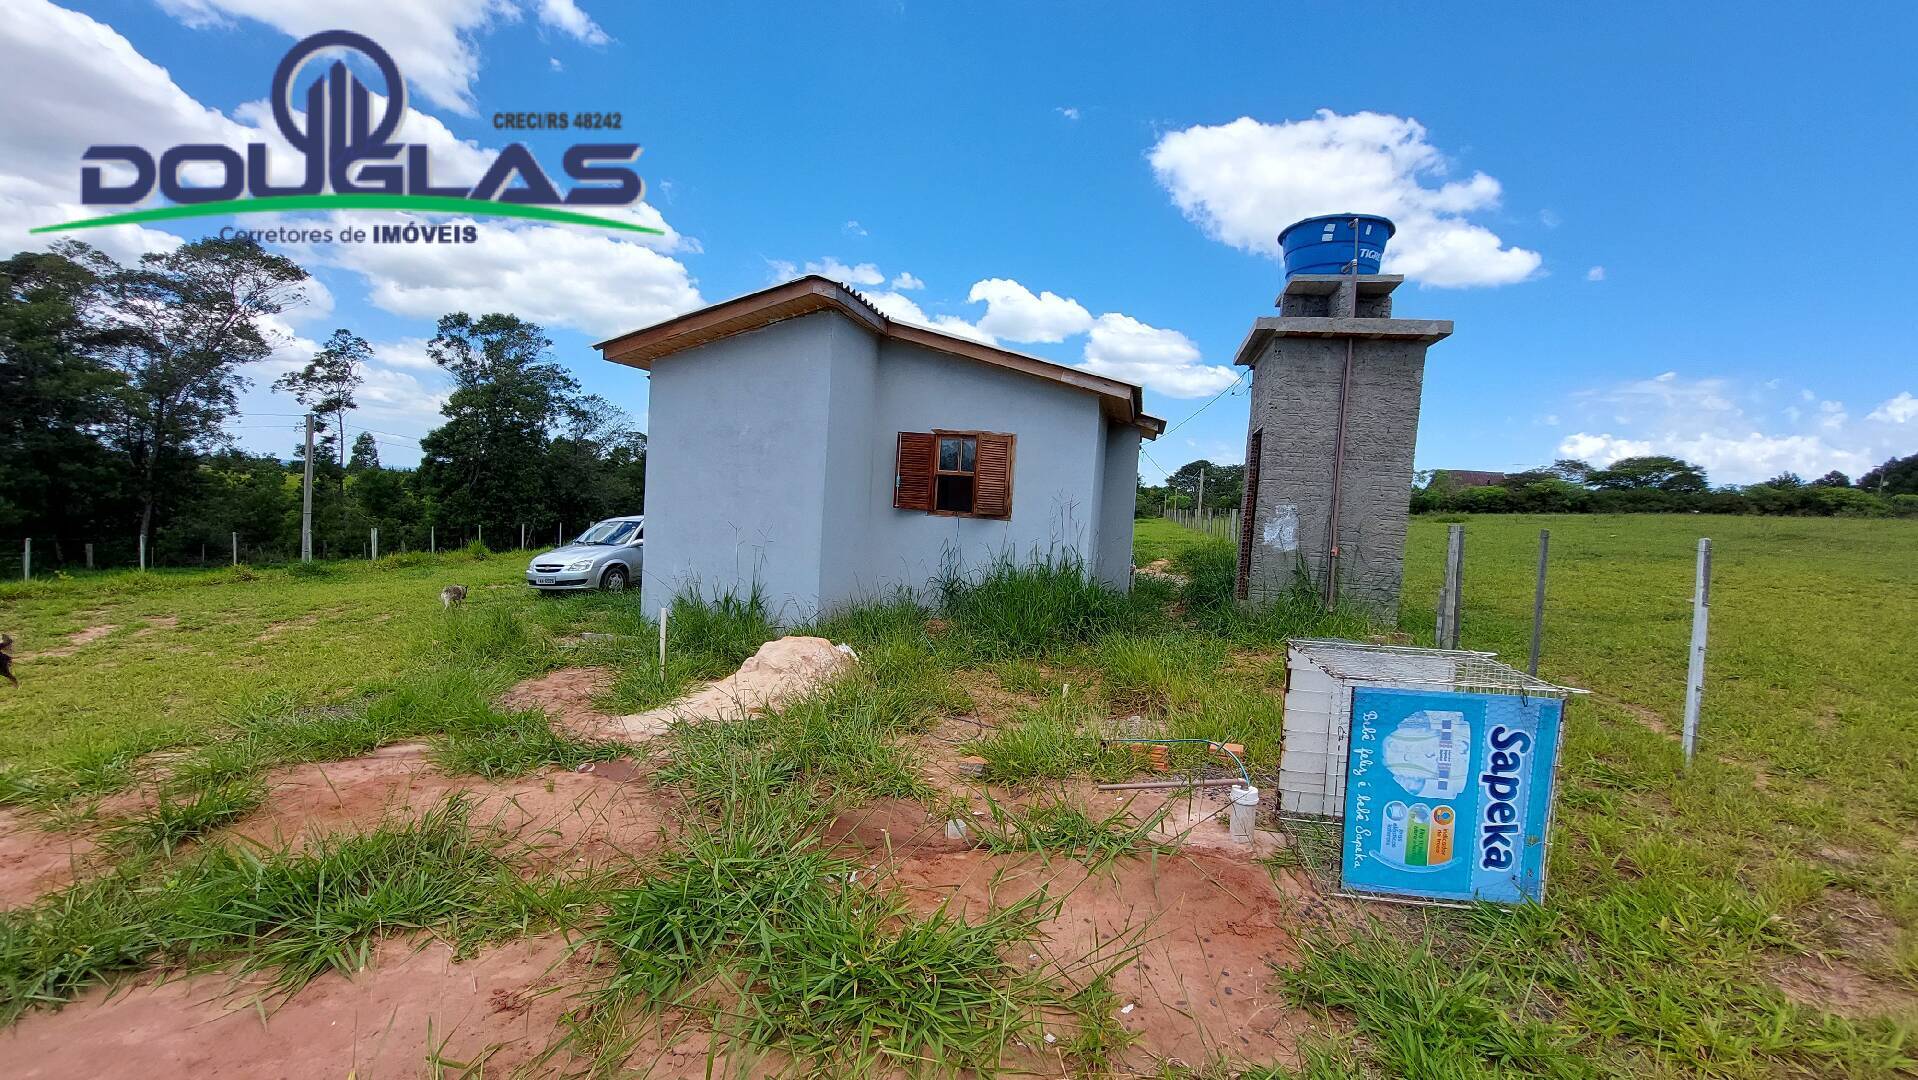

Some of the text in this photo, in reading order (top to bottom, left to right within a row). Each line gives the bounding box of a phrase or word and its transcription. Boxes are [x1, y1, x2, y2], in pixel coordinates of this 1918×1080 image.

[1361, 710, 1379, 742] Bebê
[1356, 794, 1371, 822] bebê
[1480, 726, 1532, 871] Sapeka
[1352, 825, 1371, 869] Sapeka
